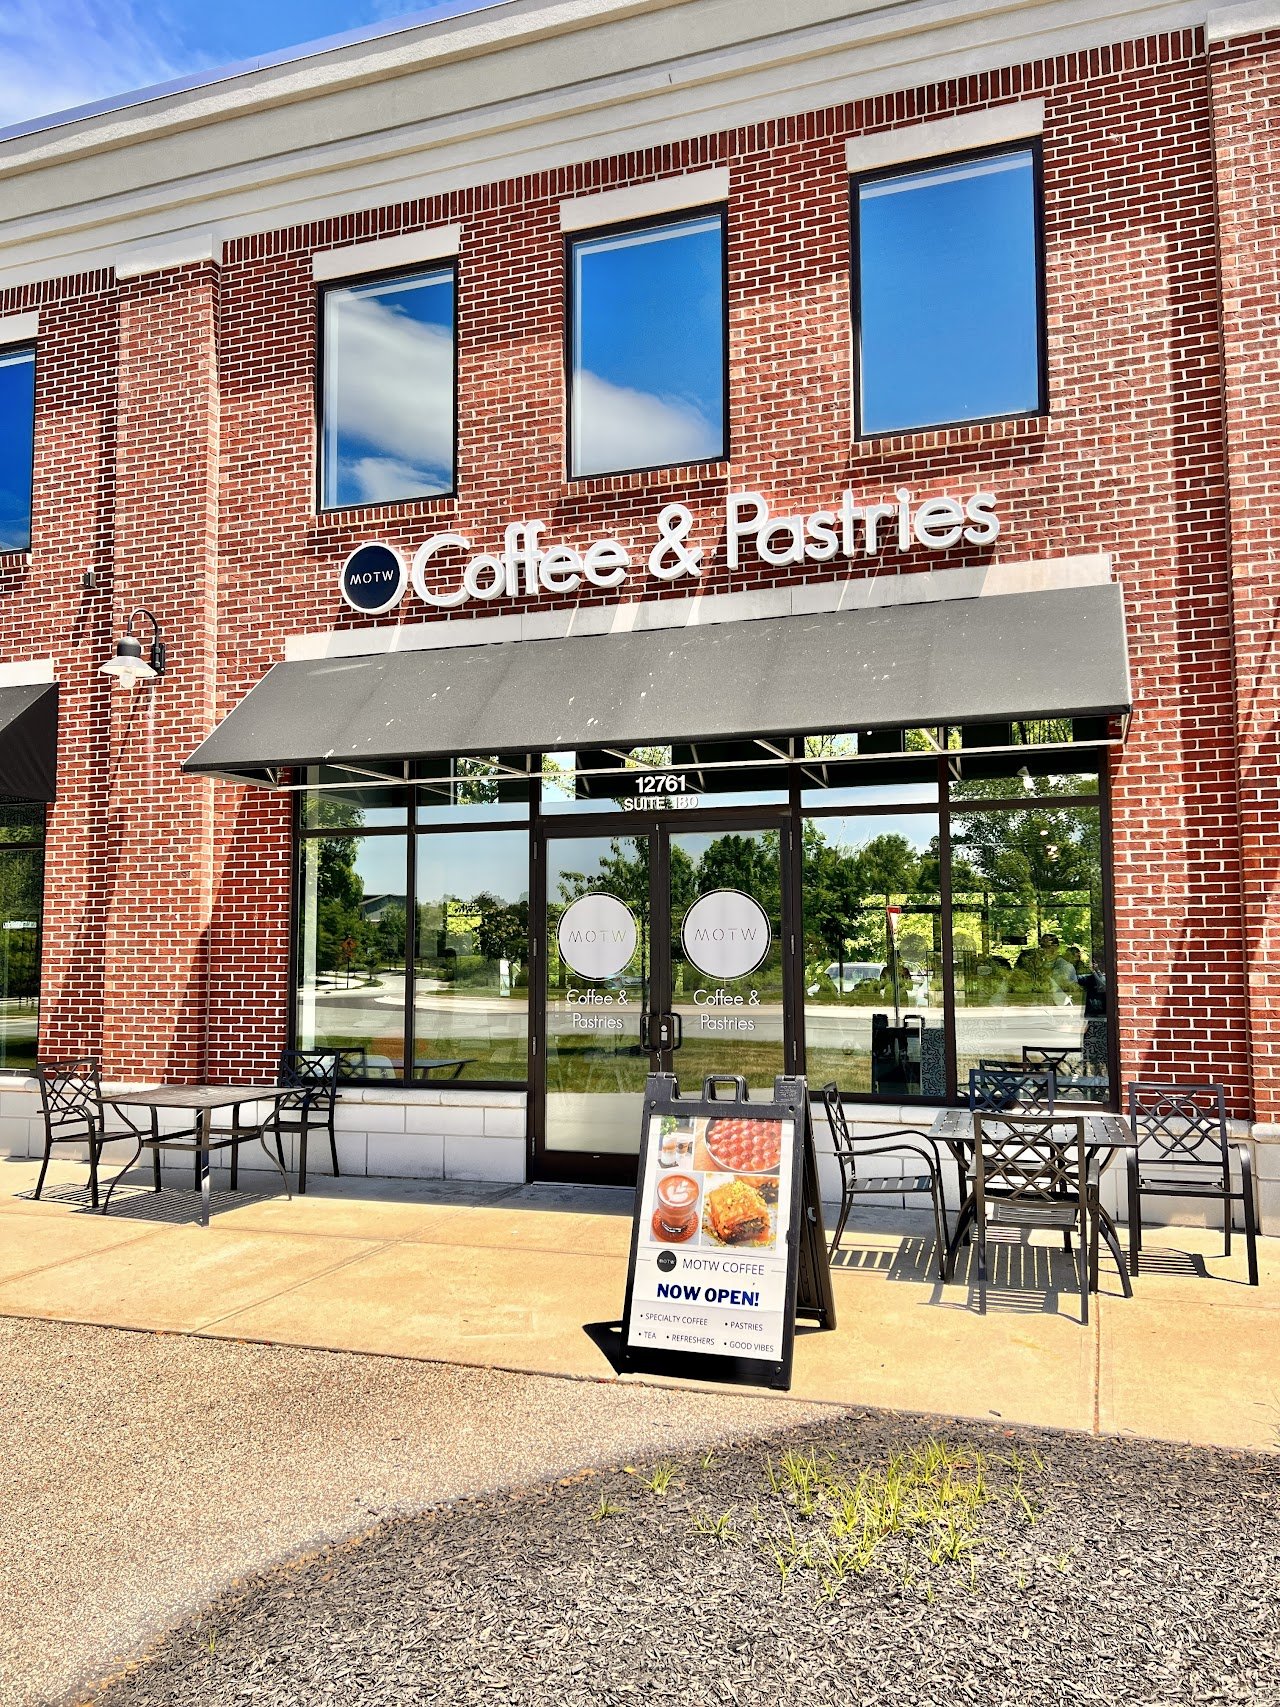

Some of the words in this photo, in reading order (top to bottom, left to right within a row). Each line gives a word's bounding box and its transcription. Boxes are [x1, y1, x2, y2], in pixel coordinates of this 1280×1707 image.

[411, 520, 630, 608] Coffee
[648, 502, 703, 582] &
[725, 487, 1000, 571] Pastries
[349, 569, 394, 586] MOTW
[635, 774, 686, 794] 12761
[623, 795, 666, 812] SUITE
[674, 795, 699, 809] 180
[568, 929, 627, 943] MOTW
[694, 927, 758, 942] MOTW
[566, 988, 613, 1005] Coffee
[617, 989, 629, 1006] &
[693, 988, 744, 1006] Coffee
[748, 989, 761, 1006] &
[572, 1012, 623, 1029] Pastries
[701, 1013, 755, 1031] Pastries
[682, 1258, 720, 1271] MOTW
[722, 1261, 765, 1276] COFFEE
[656, 1283, 701, 1301] NOW
[704, 1287, 760, 1307] OPEN!
[645, 1312, 681, 1323] SPECIALTY
[682, 1316, 708, 1326] COFFEE
[730, 1321, 763, 1332] PASTRIES
[644, 1331, 657, 1340] TEA
[671, 1334, 715, 1346] REFRESHERS
[729, 1340, 753, 1351] GOOD
[753, 1343, 774, 1353] VIBES
